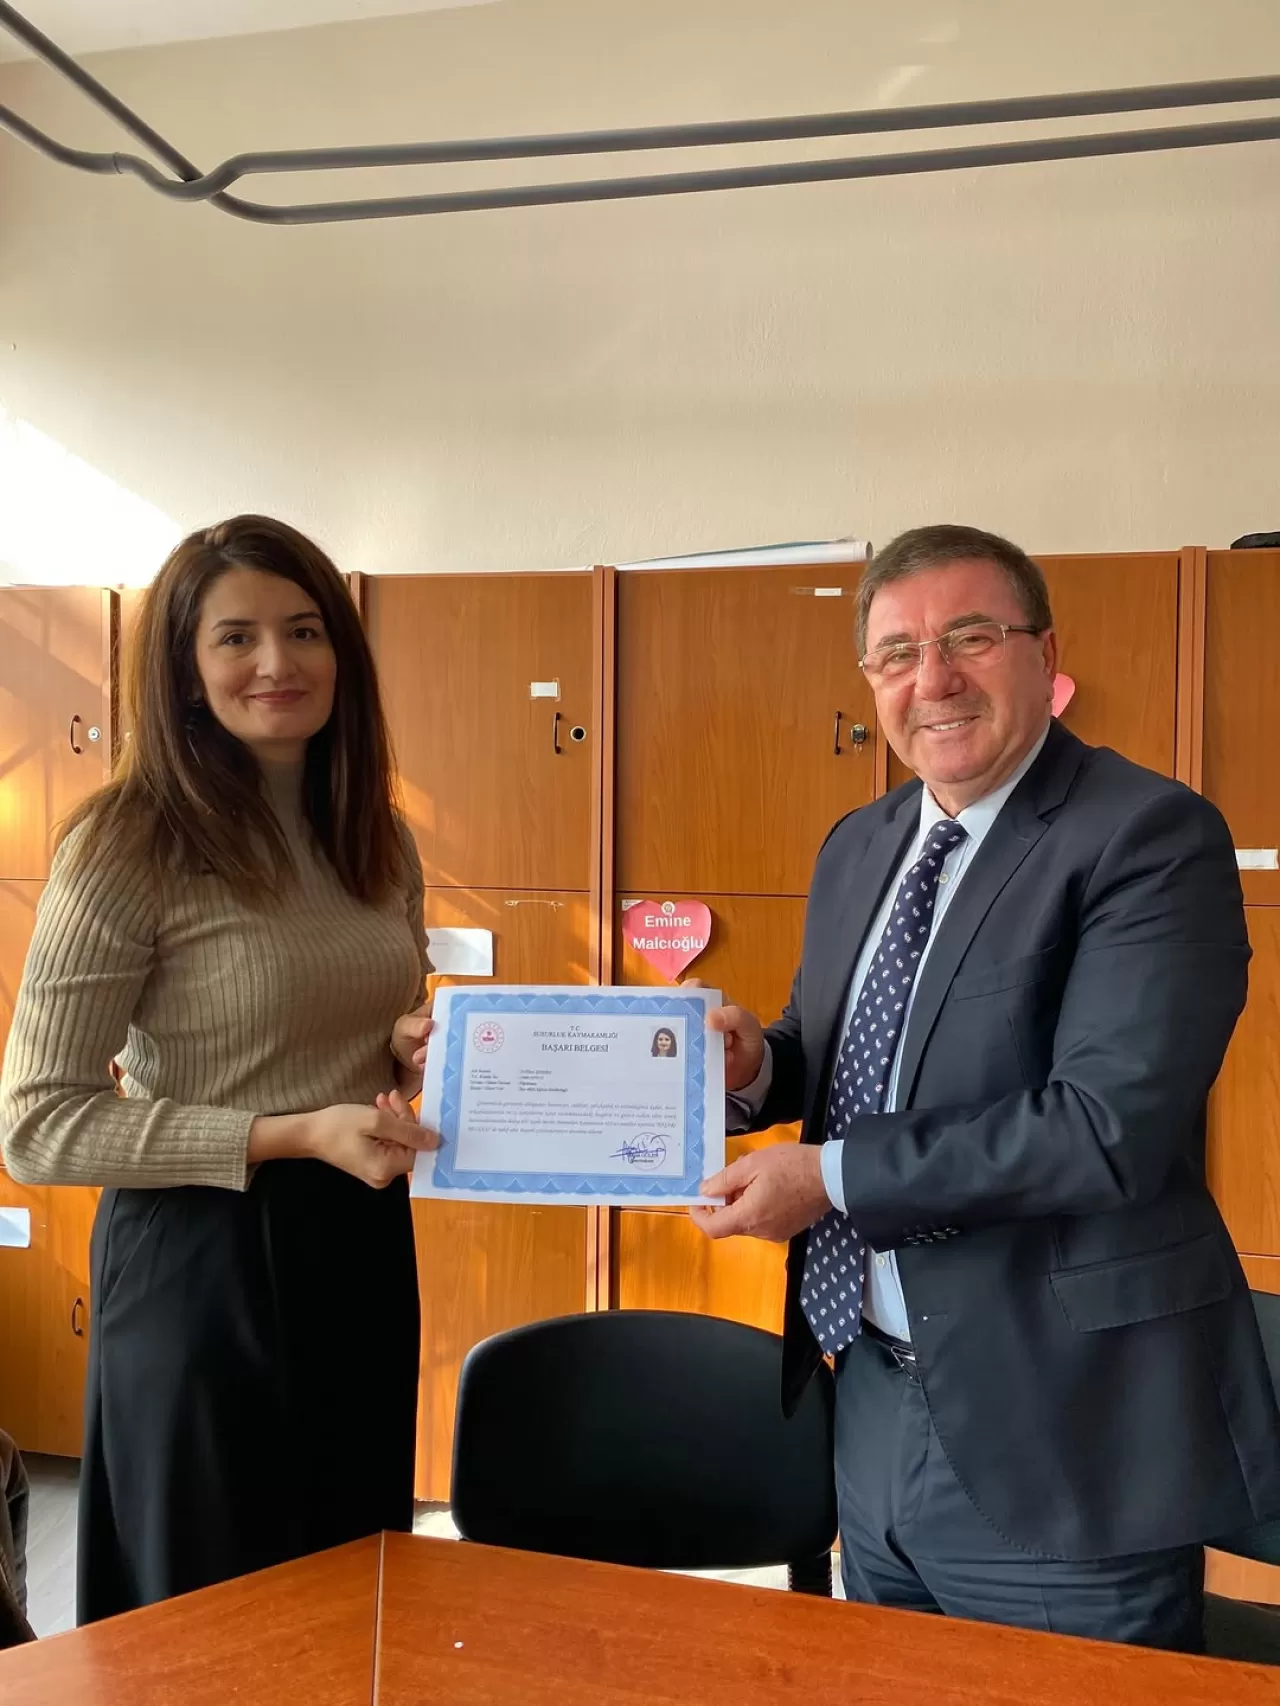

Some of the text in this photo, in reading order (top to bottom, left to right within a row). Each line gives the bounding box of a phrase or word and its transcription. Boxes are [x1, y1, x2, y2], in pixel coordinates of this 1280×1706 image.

[644, 914, 692, 928] Emine
[633, 936, 704, 952] Malcıoğlu
[541, 1043, 609, 1053] BAŞARI BELGESİ
